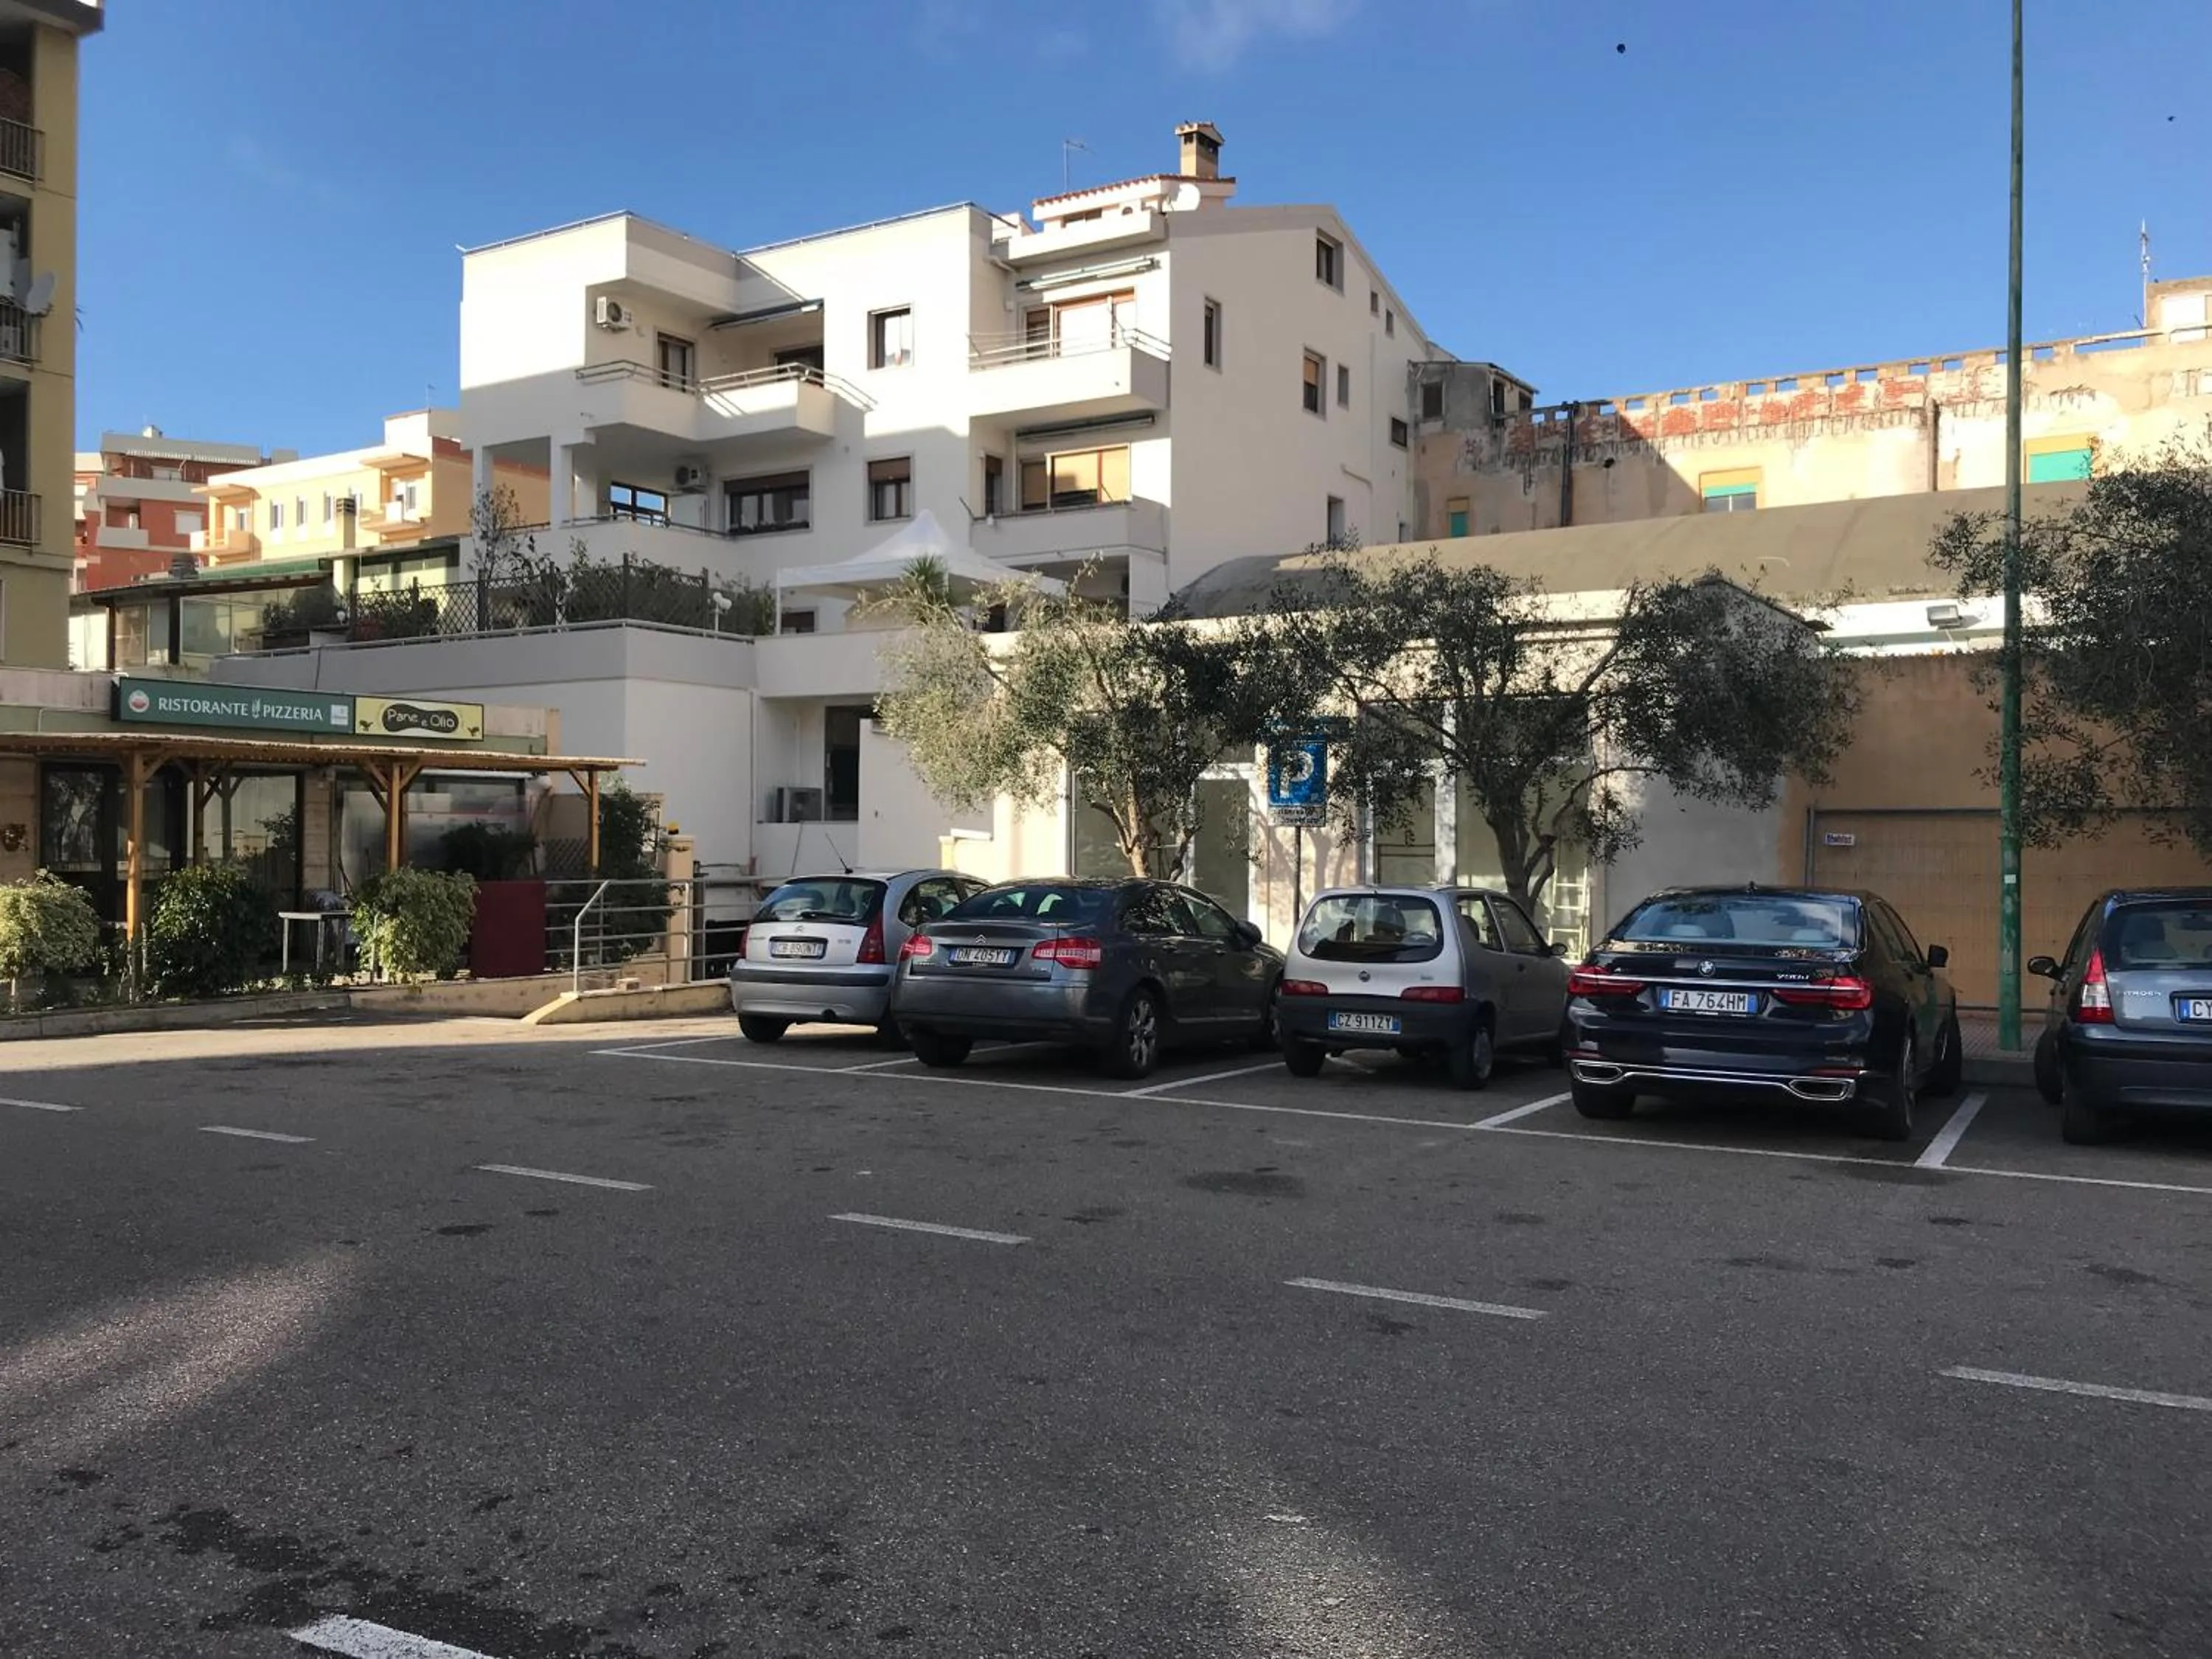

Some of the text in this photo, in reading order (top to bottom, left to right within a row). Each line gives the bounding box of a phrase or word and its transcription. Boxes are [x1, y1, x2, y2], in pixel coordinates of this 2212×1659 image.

[159, 697, 324, 721] RISTORANTE PIZZERIA
[387, 709, 419, 723] Pane
[430, 714, 455, 728] Olio
[1279, 750, 1315, 799] P
[1671, 992, 1747, 1010] FA 764HM
[1338, 1014, 1392, 1029] CZ 911ZY
